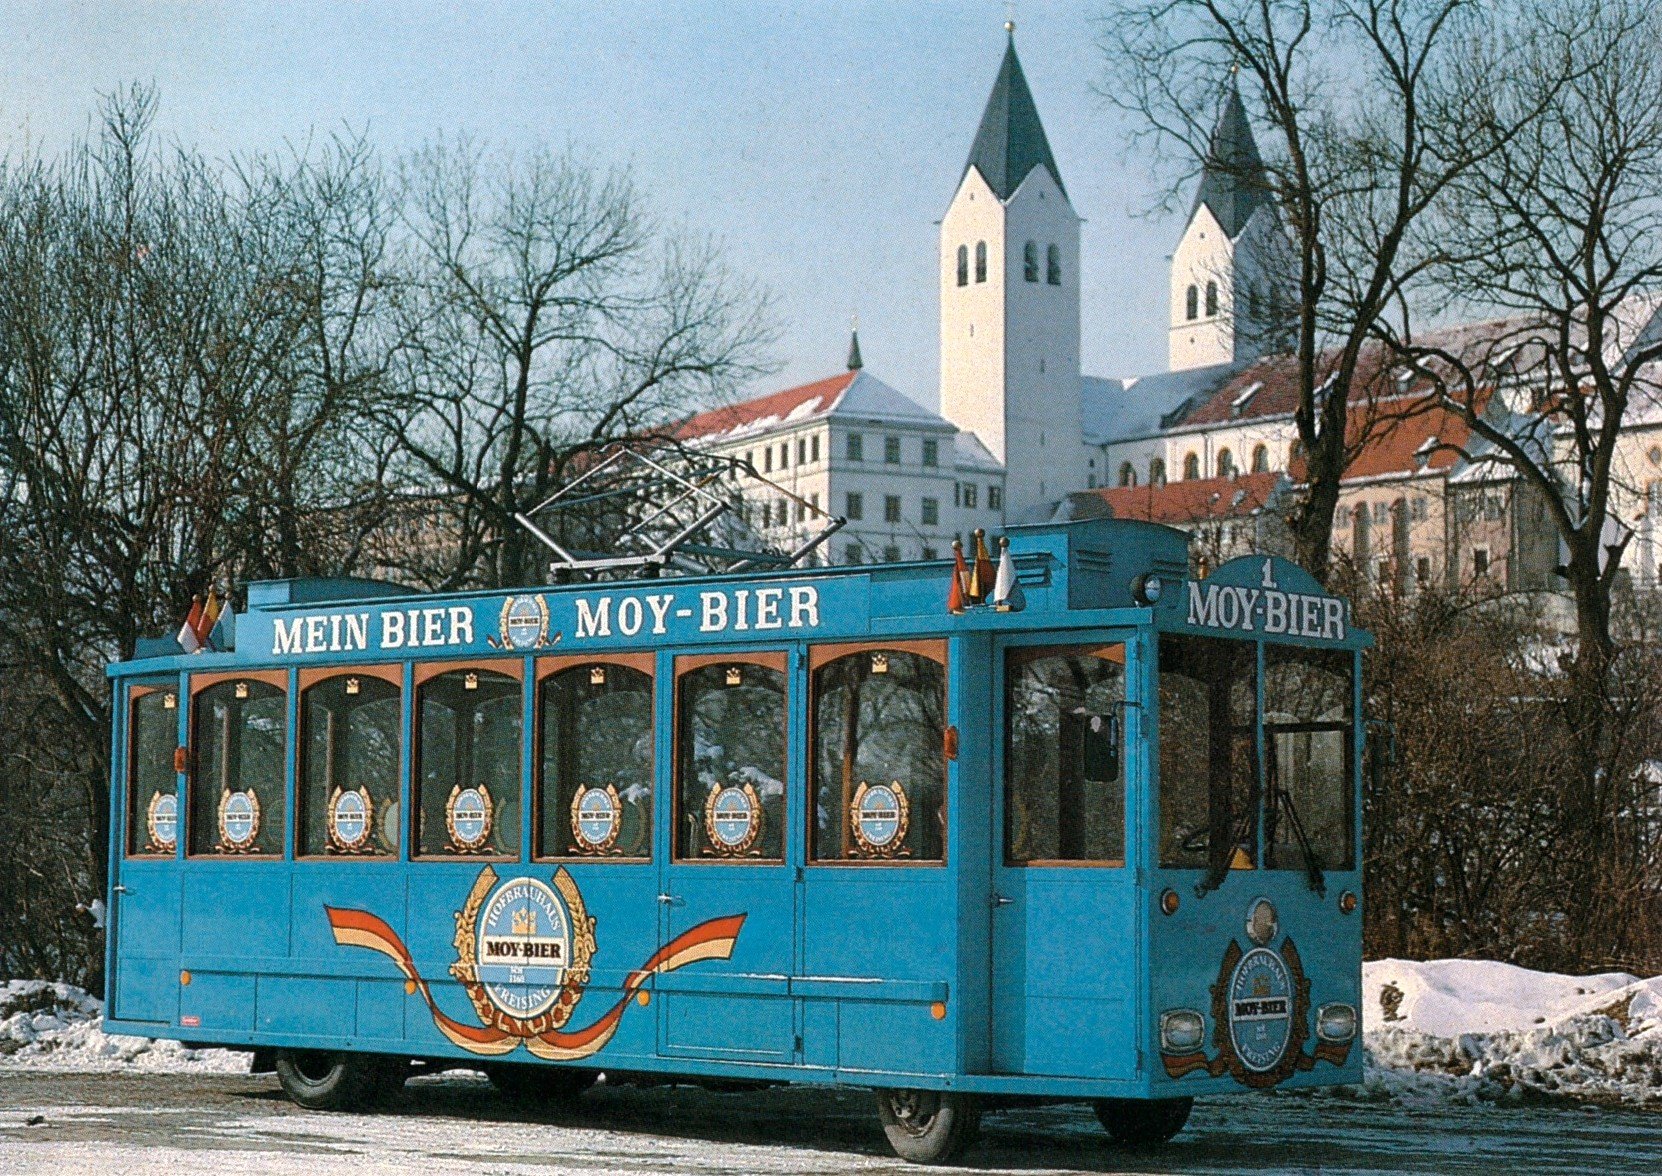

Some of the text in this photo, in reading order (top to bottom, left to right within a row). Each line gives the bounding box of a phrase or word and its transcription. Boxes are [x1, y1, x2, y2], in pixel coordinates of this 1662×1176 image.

[272, 606, 474, 655] MEIN BIER
[575, 586, 820, 638] MOY-BIER
[1187, 580, 1345, 641] MOY-BIER
[486, 940, 562, 960] MOY-BIER
[494, 982, 552, 1011] FREISING
